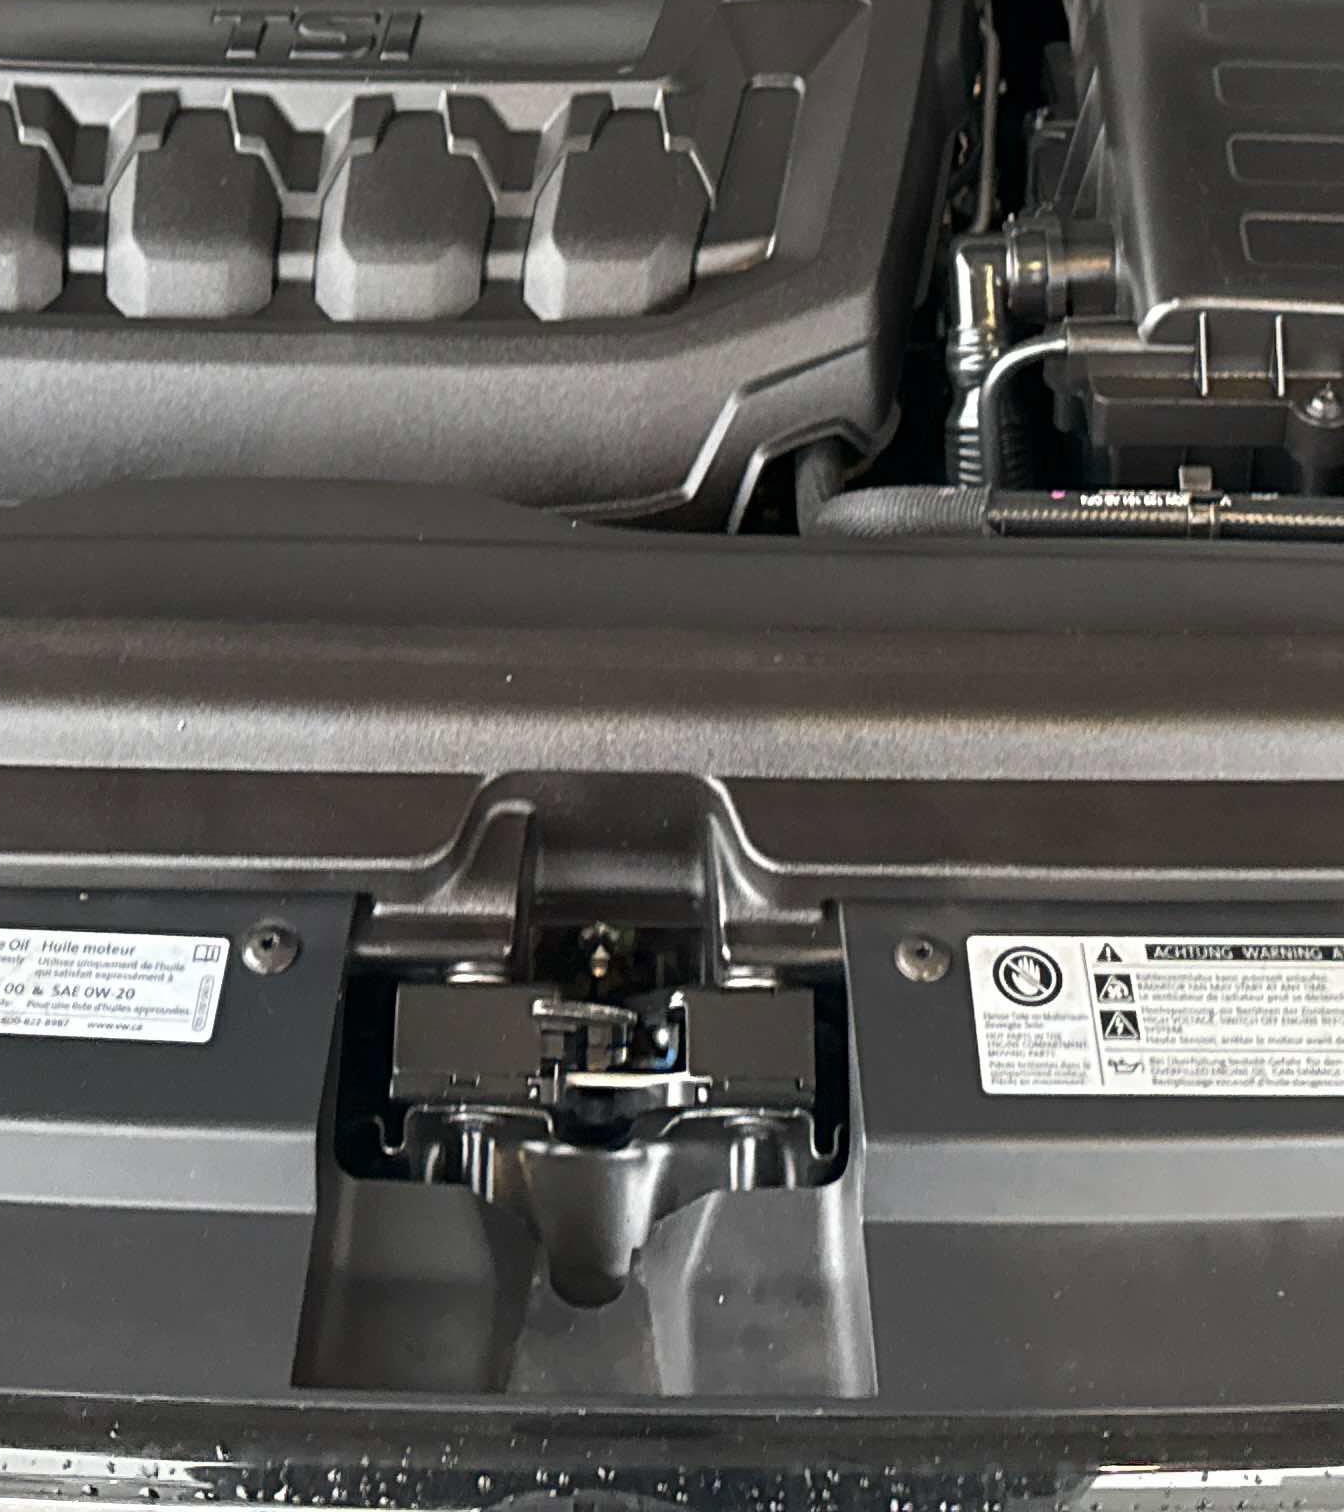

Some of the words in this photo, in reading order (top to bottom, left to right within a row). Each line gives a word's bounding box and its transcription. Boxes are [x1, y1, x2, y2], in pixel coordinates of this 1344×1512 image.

[211, 8, 422, 61] TSI
[8, 937, 31, 952] Oil
[42, 939, 80, 954] Huile
[82, 941, 137, 957] moteur
[1154, 945, 1234, 960] ACHTUNG
[1241, 945, 1323, 960] WARNING
[3, 982, 26, 996] 00
[31, 985, 44, 996] &
[49, 983, 82, 998] SAE
